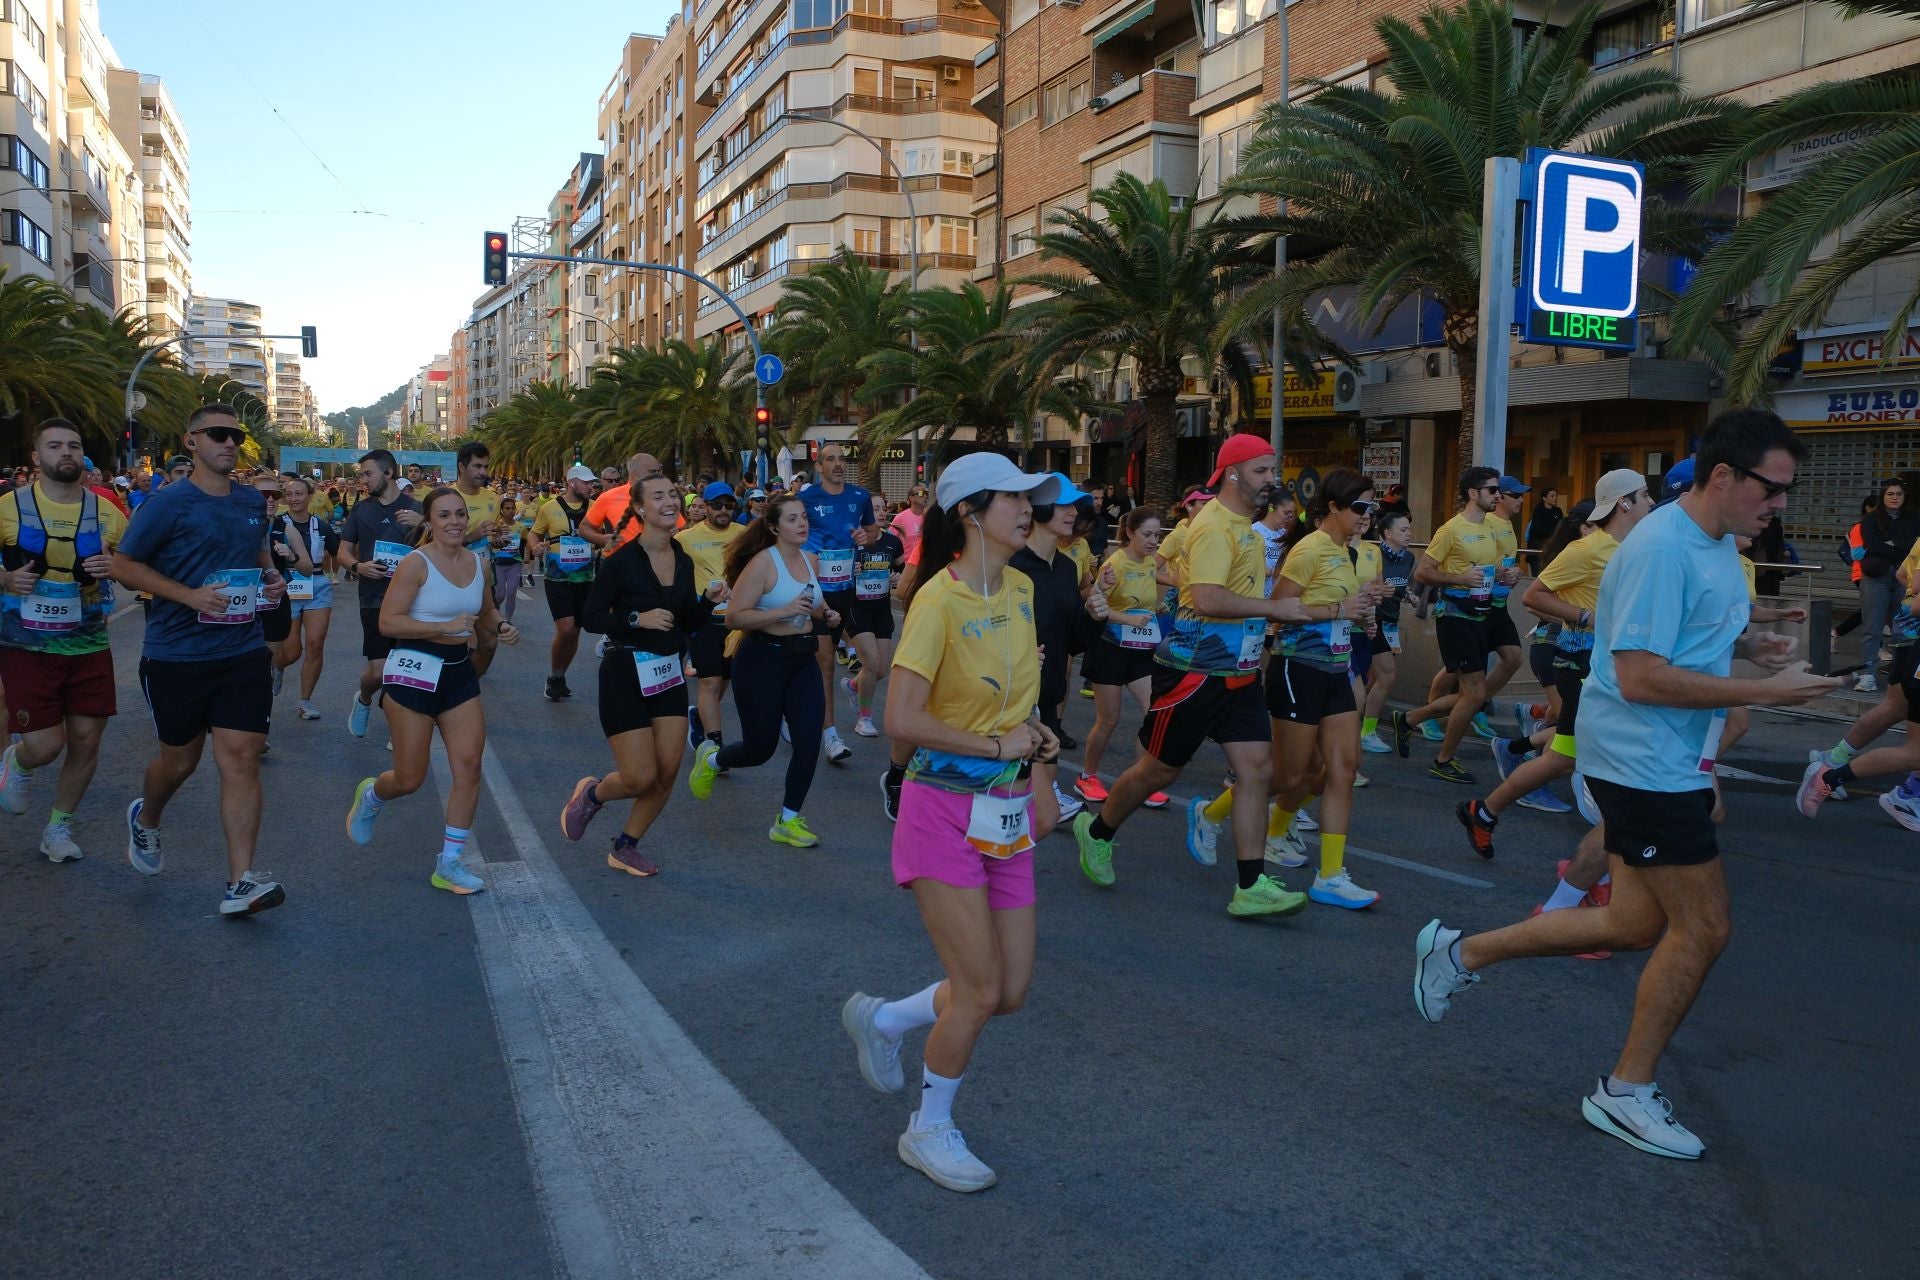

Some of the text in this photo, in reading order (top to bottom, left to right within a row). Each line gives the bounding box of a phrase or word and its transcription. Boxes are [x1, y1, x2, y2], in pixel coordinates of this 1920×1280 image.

[1561, 173, 1637, 294] P
[1549, 311, 1617, 341] LIBRE
[1822, 334, 1920, 363] EXCHN
[1828, 389, 1919, 412] EURO
[1827, 409, 1911, 424] MONEY
[34, 603, 69, 616] 3395
[1131, 627, 1153, 636] 4783
[397, 657, 423, 671] 524
[653, 662, 673, 677] 1169
